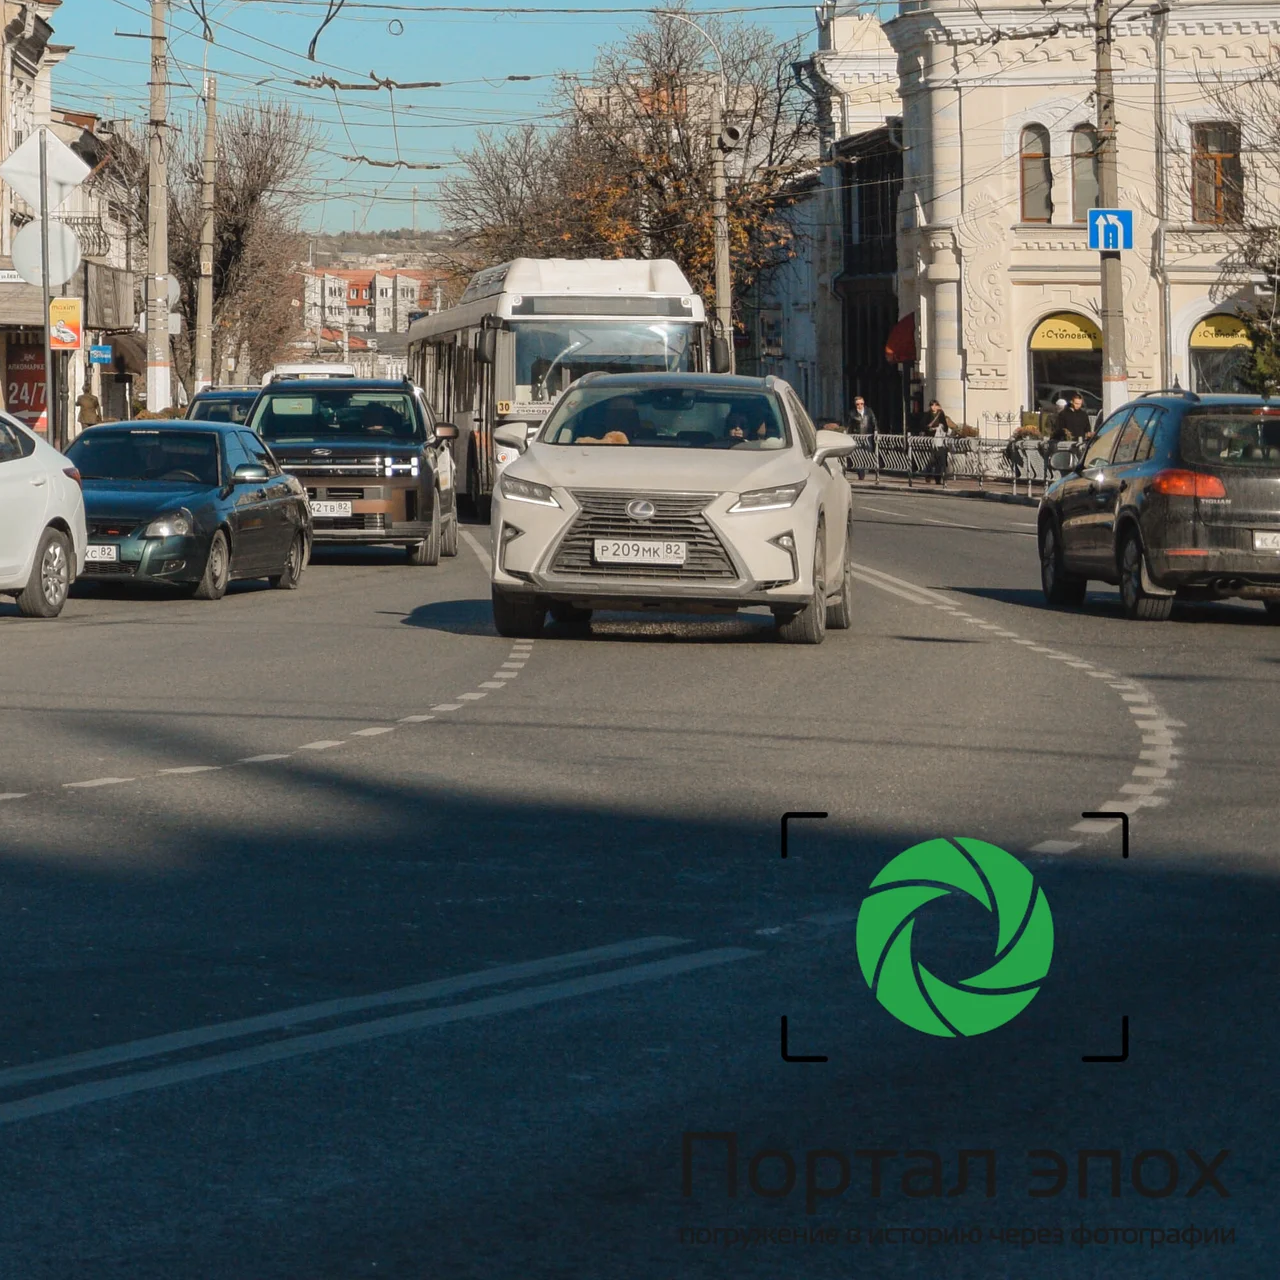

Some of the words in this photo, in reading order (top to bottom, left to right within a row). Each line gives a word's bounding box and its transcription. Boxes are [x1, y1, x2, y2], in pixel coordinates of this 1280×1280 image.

[8, 382, 46, 406] 24/7
[499, 403, 510, 412] 30
[338, 502, 348, 510] 82
[101, 547, 112, 556] 82
[601, 543, 660, 557] Р209МК
[665, 544, 680, 555] 82
